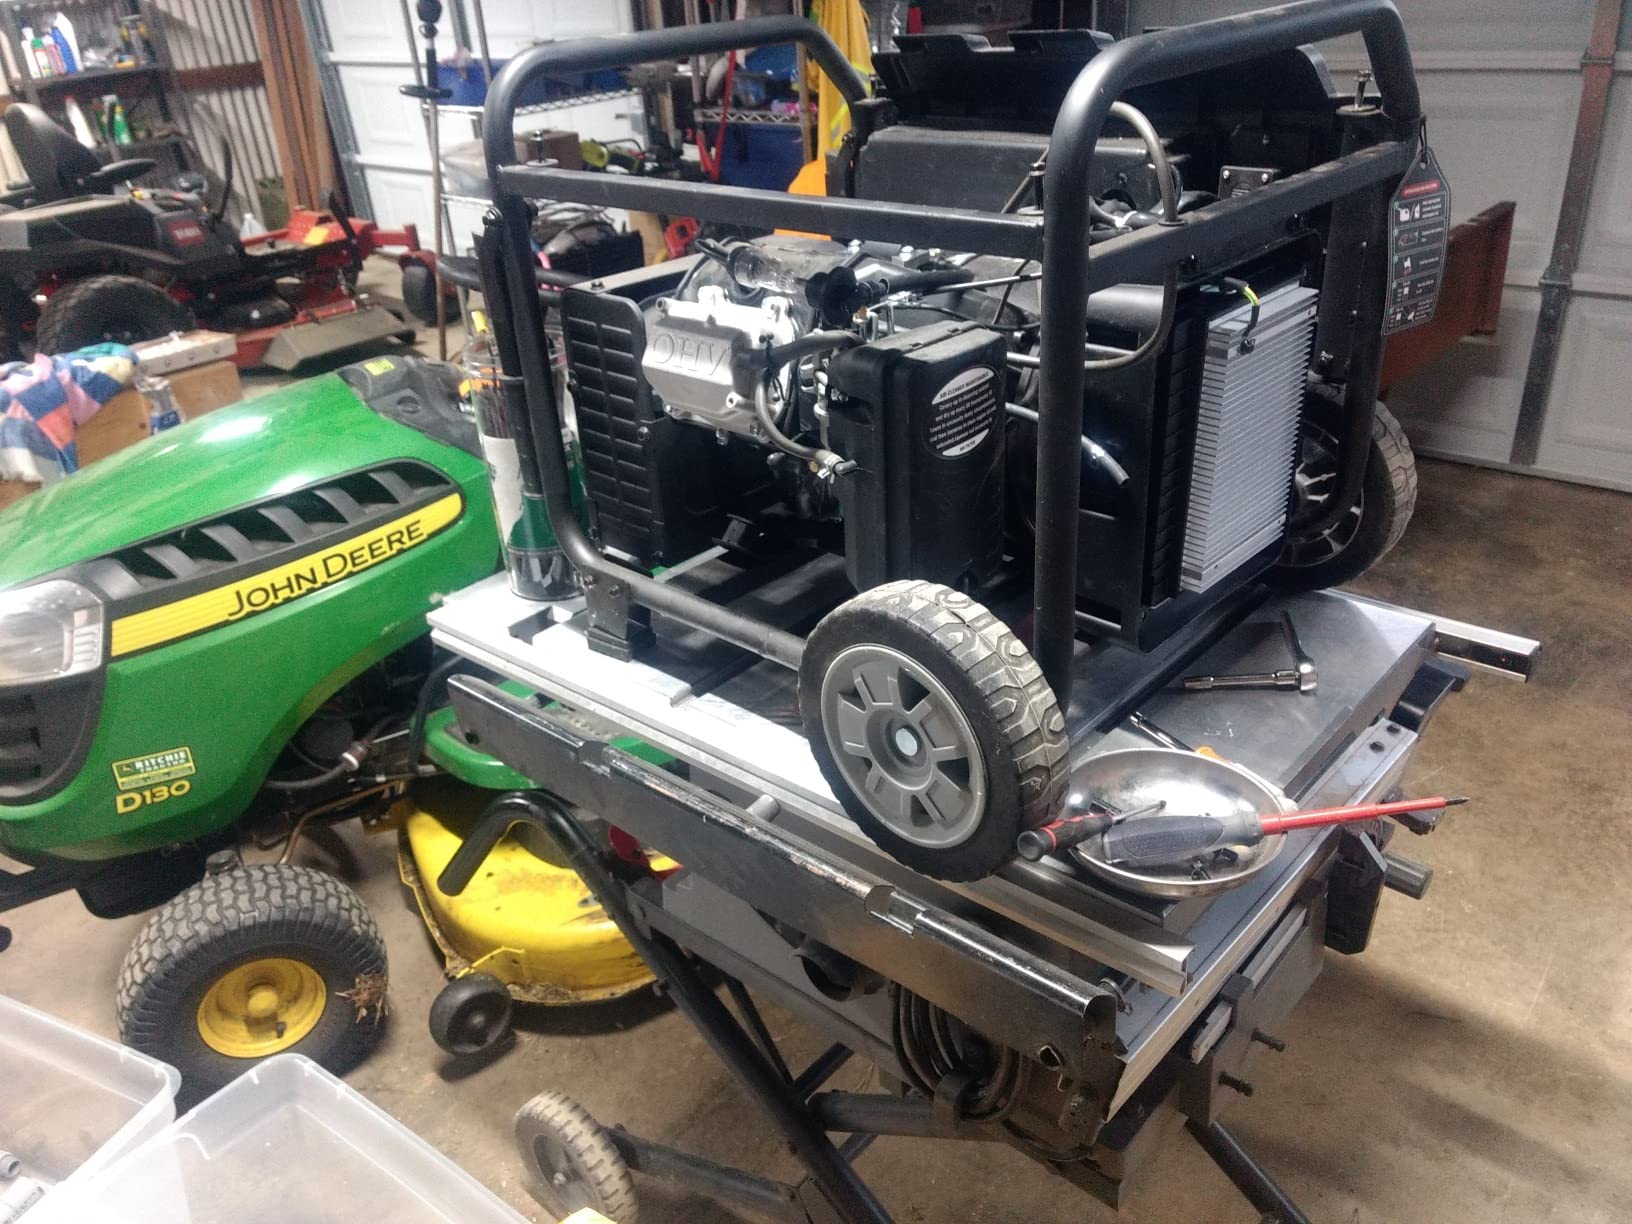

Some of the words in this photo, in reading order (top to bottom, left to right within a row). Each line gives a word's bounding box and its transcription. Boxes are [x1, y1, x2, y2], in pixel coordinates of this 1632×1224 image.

[653, 333, 730, 376] OHV
[948, 384, 965, 395] CLEANER
[227, 566, 318, 618] JOHN
[322, 520, 425, 580] DEERE
[135, 751, 186, 770] RITCHIE
[116, 780, 191, 814] D130
